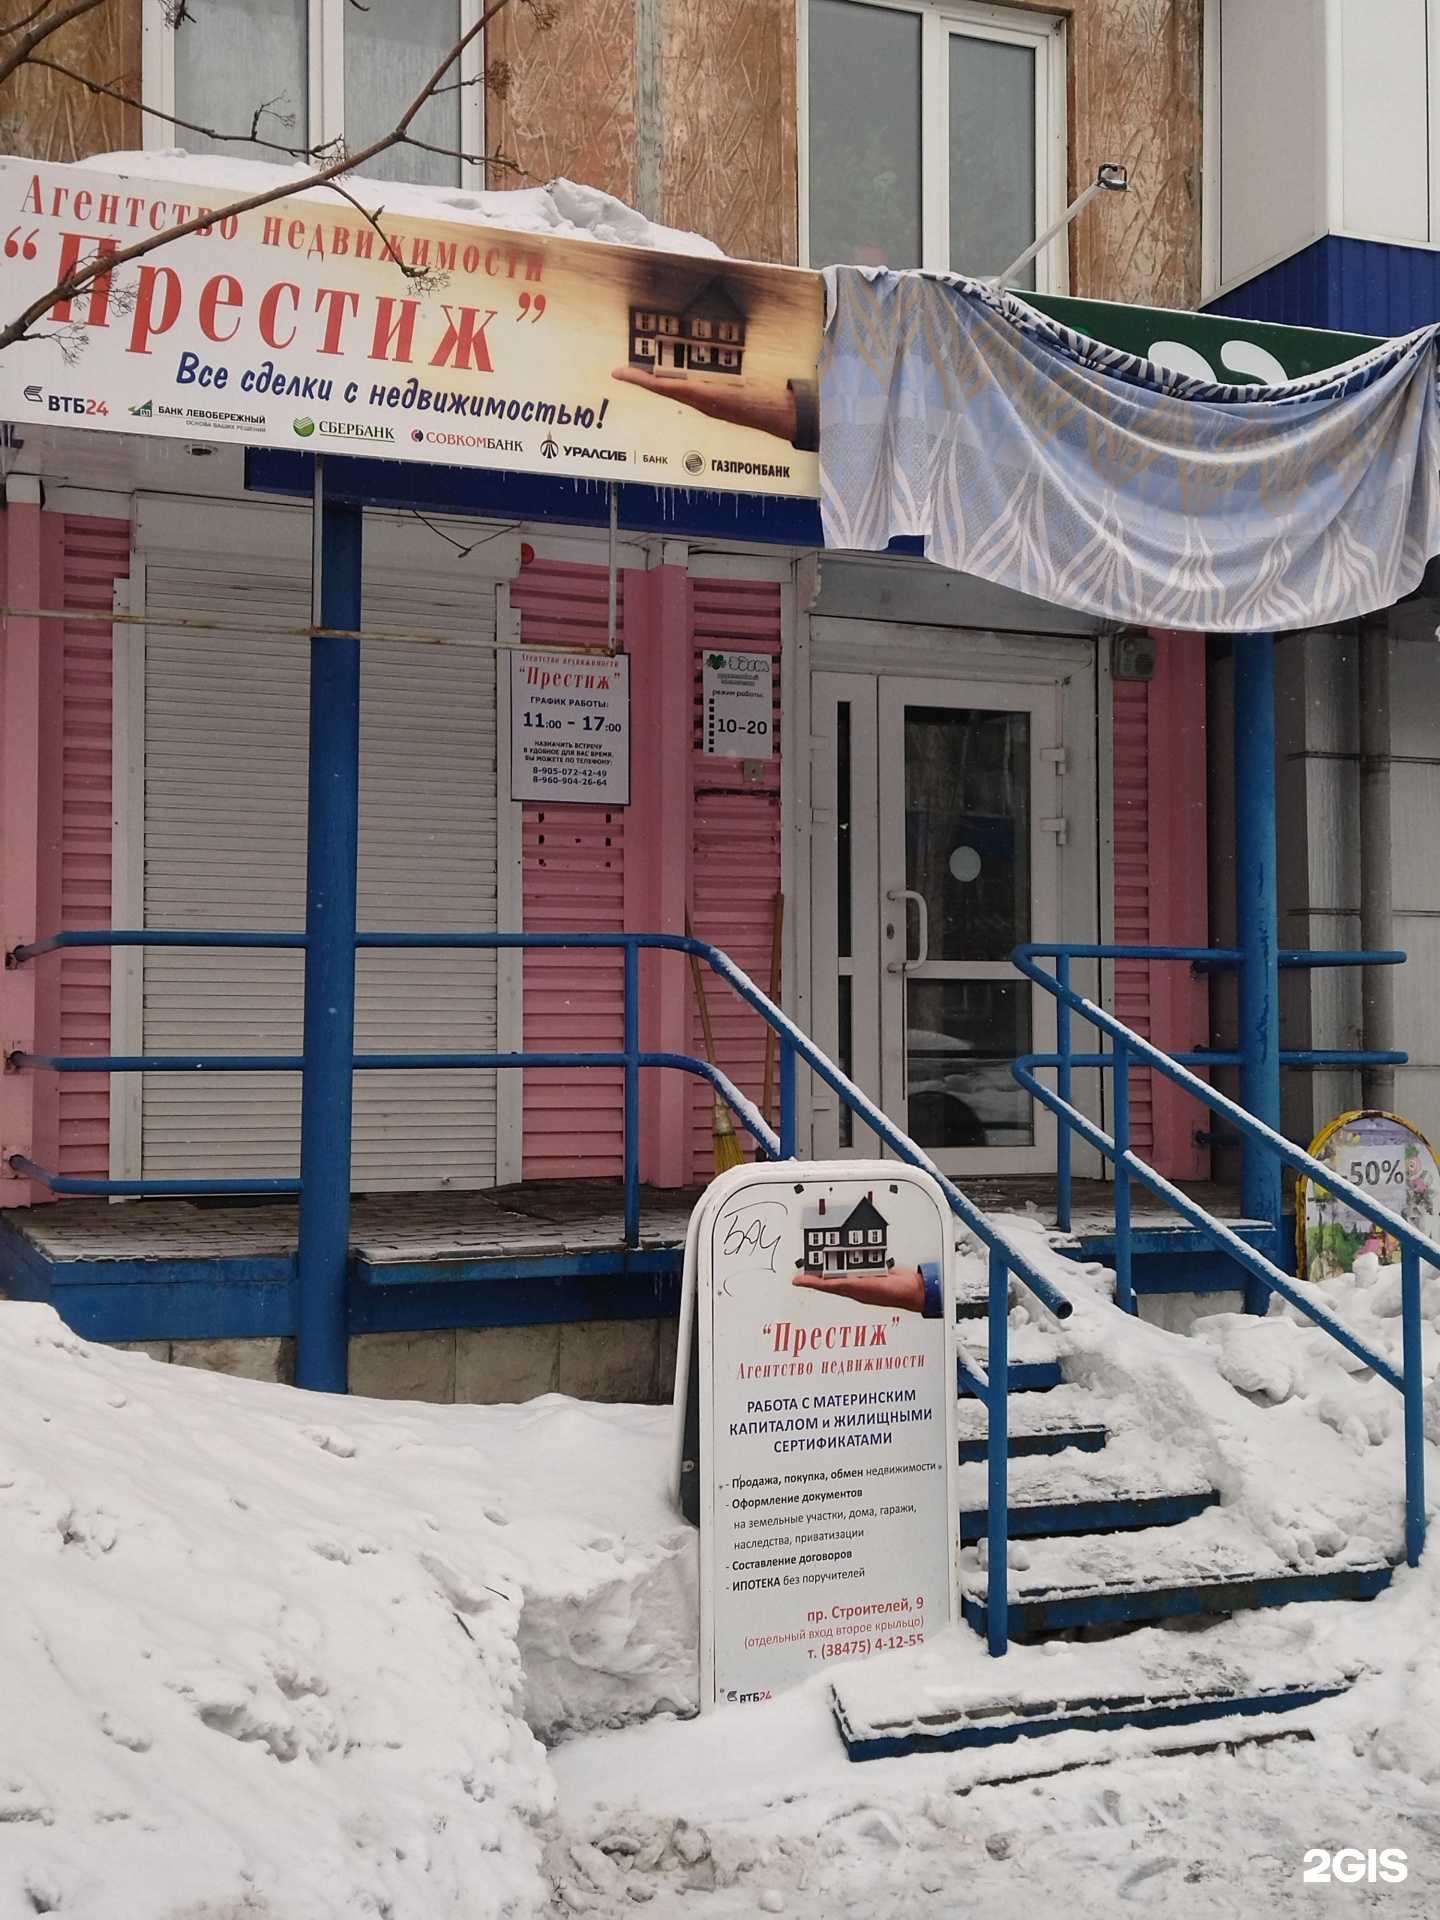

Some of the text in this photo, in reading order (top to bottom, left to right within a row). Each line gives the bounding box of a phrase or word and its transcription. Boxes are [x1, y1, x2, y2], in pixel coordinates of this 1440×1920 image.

[20, 174, 545, 283] Агентство недвижимости
[176, 351, 609, 430] Все сделки с недвижимостью!
[48, 395, 109, 416] ВТБ24
[158, 406, 266, 424] БАНК ЛЕВОБЕРЕЖНЫЙ
[319, 420, 395, 440] СБЕРБАНК
[426, 431, 523, 452] СОВКОМБАНК
[563, 446, 668, 465] УРАЛСИБ БАНК
[711, 458, 791, 478] ГАЗПРОМБАНК
[530, 696, 609, 708] ГРАФИК РАБОТЫ:
[523, 711, 561, 728] 11:00
[582, 716, 621, 732] 17:00
[717, 719, 767, 734] 10-20
[736, 1353, 926, 1380] Агентство недвижимости
[747, 1389, 916, 1413] РАБОТА С МАТЕРИНСКИМ
[729, 1408, 932, 1436] КАПИТАЛОМ и ЖИЛИЩНЫМИ
[774, 1432, 892, 1453] СЕРТИФИКАТАМИ
[732, 1476, 782, 1490] Продажа,
[784, 1471, 828, 1486] покупка,
[831, 1468, 863, 1480] обмен
[866, 1462, 936, 1478] недвижимости
[732, 1495, 799, 1512] Оформление
[802, 1488, 863, 1503] документов
[734, 1504, 917, 1530] на земельные участки, дома, гаражи,
[734, 1529, 864, 1550] наследства, приватизации
[732, 1555, 797, 1571] Составление
[799, 1550, 852, 1566] договоров
[733, 1577, 781, 1592] ИПОТЕКА
[783, 1574, 800, 1586] без
[802, 1568, 865, 1585] поручителей
[807, 1596, 924, 1623] пр. Строителей, 9
[744, 1616, 924, 1650] (отдельный вход второе крыльцо)
[808, 1633, 924, 1660] т. (38475) 4-12-55
